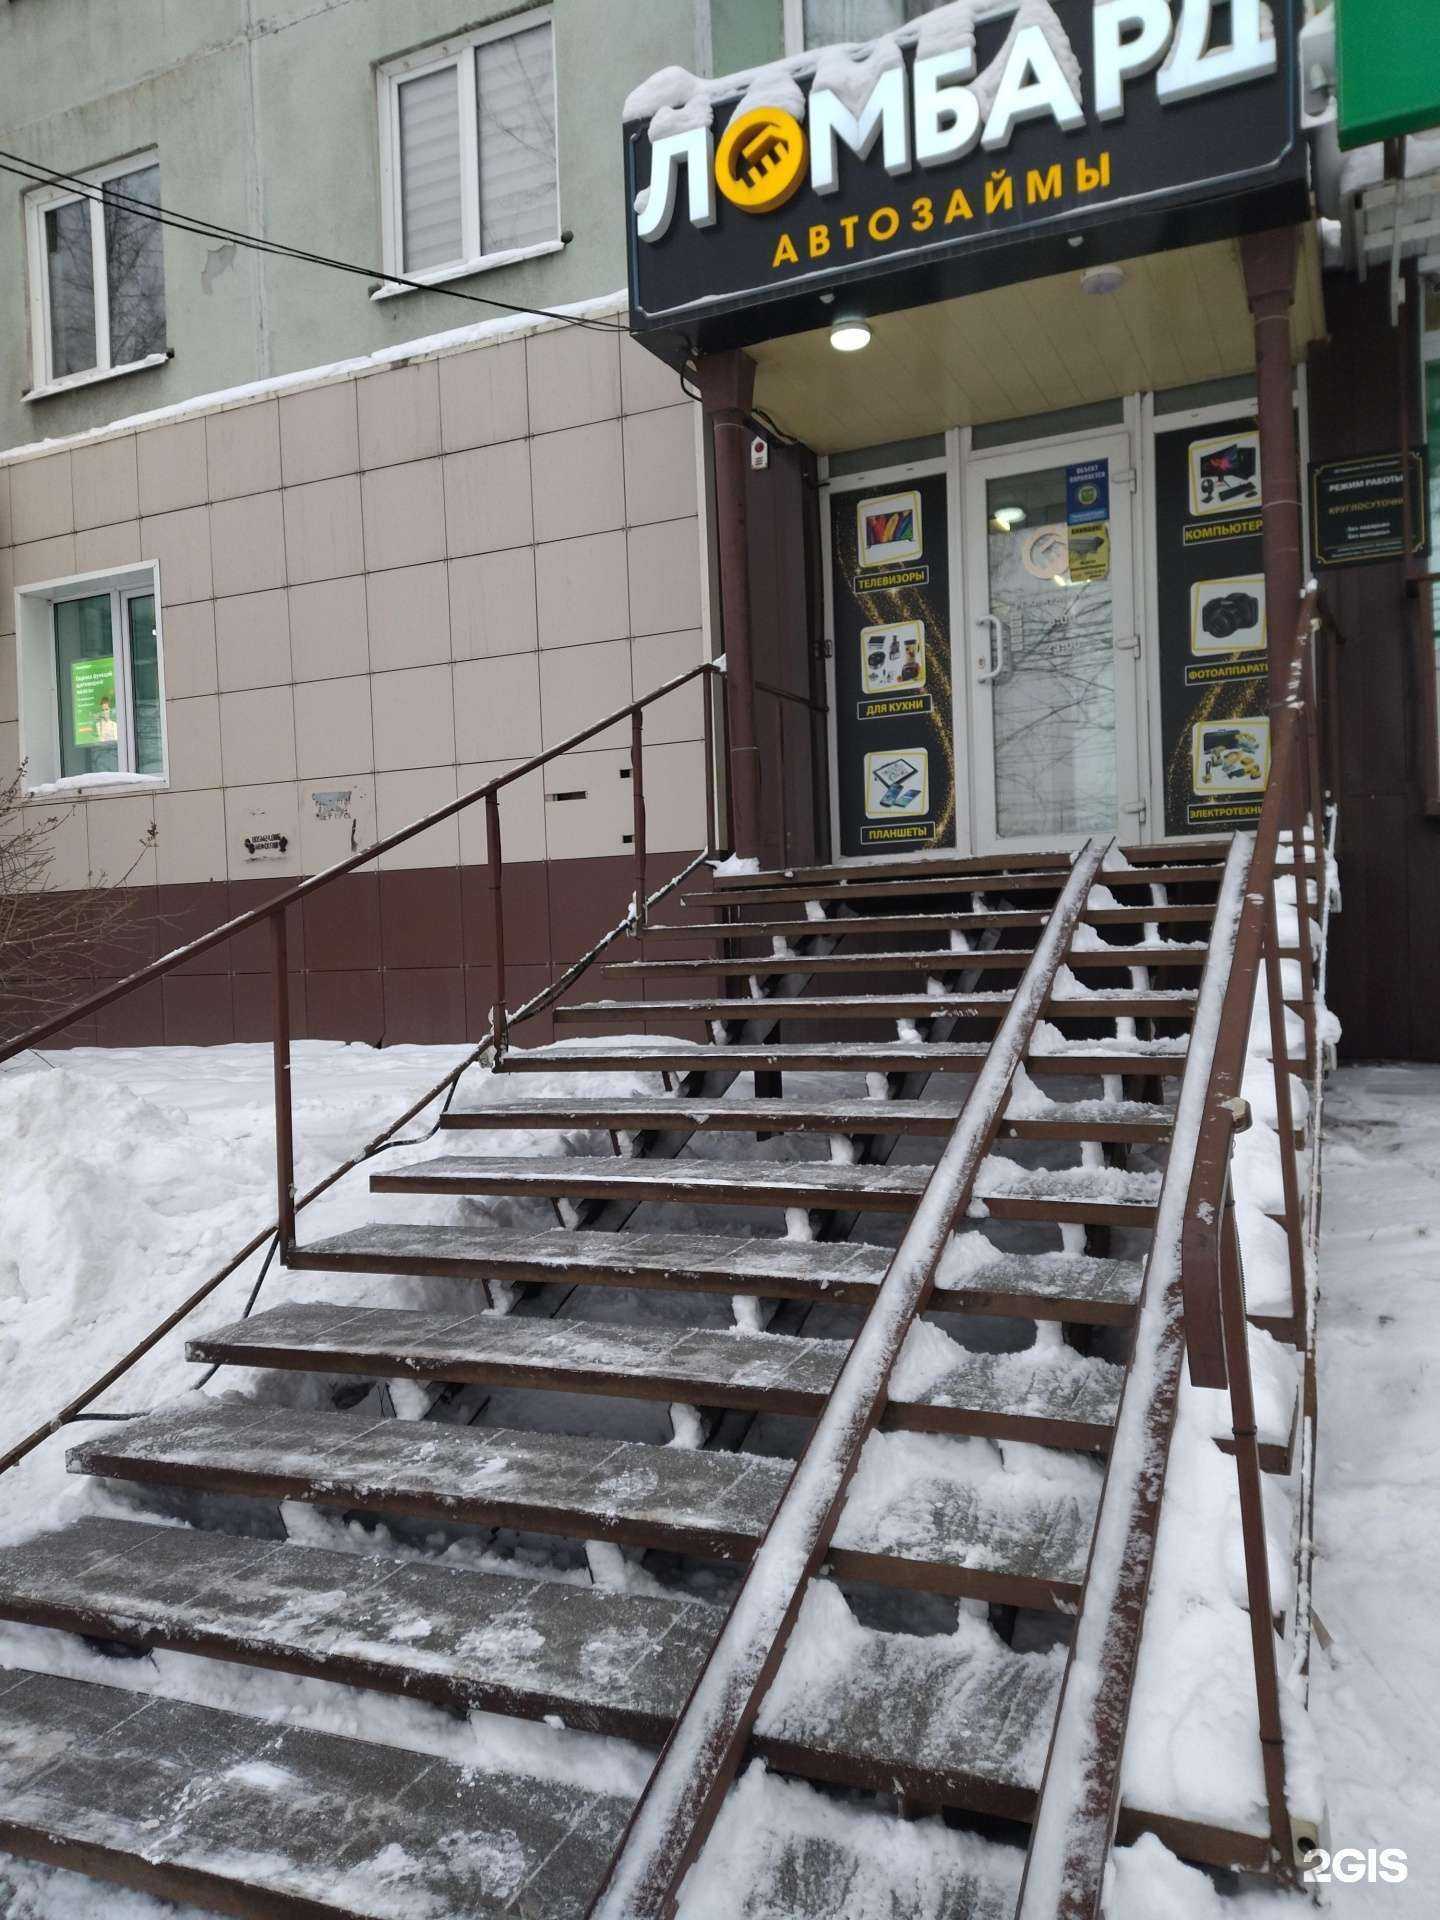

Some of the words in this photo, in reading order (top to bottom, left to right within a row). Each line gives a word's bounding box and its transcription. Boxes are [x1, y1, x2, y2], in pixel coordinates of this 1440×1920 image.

[637, 0, 1278, 243] ЛОМБАРД
[772, 152, 1110, 268] АВТОЗАЙМЫ
[1328, 480, 1364, 493] РЕЖИМ
[1365, 475, 1404, 487] РАБОТЫ
[859, 570, 925, 589] ТЕЛЕВИЗОРЫ
[866, 702, 888, 716] ДЛЯ
[888, 699, 924, 713] КУХНИ
[869, 826, 927, 840] ПЛАНШЕТЫ
